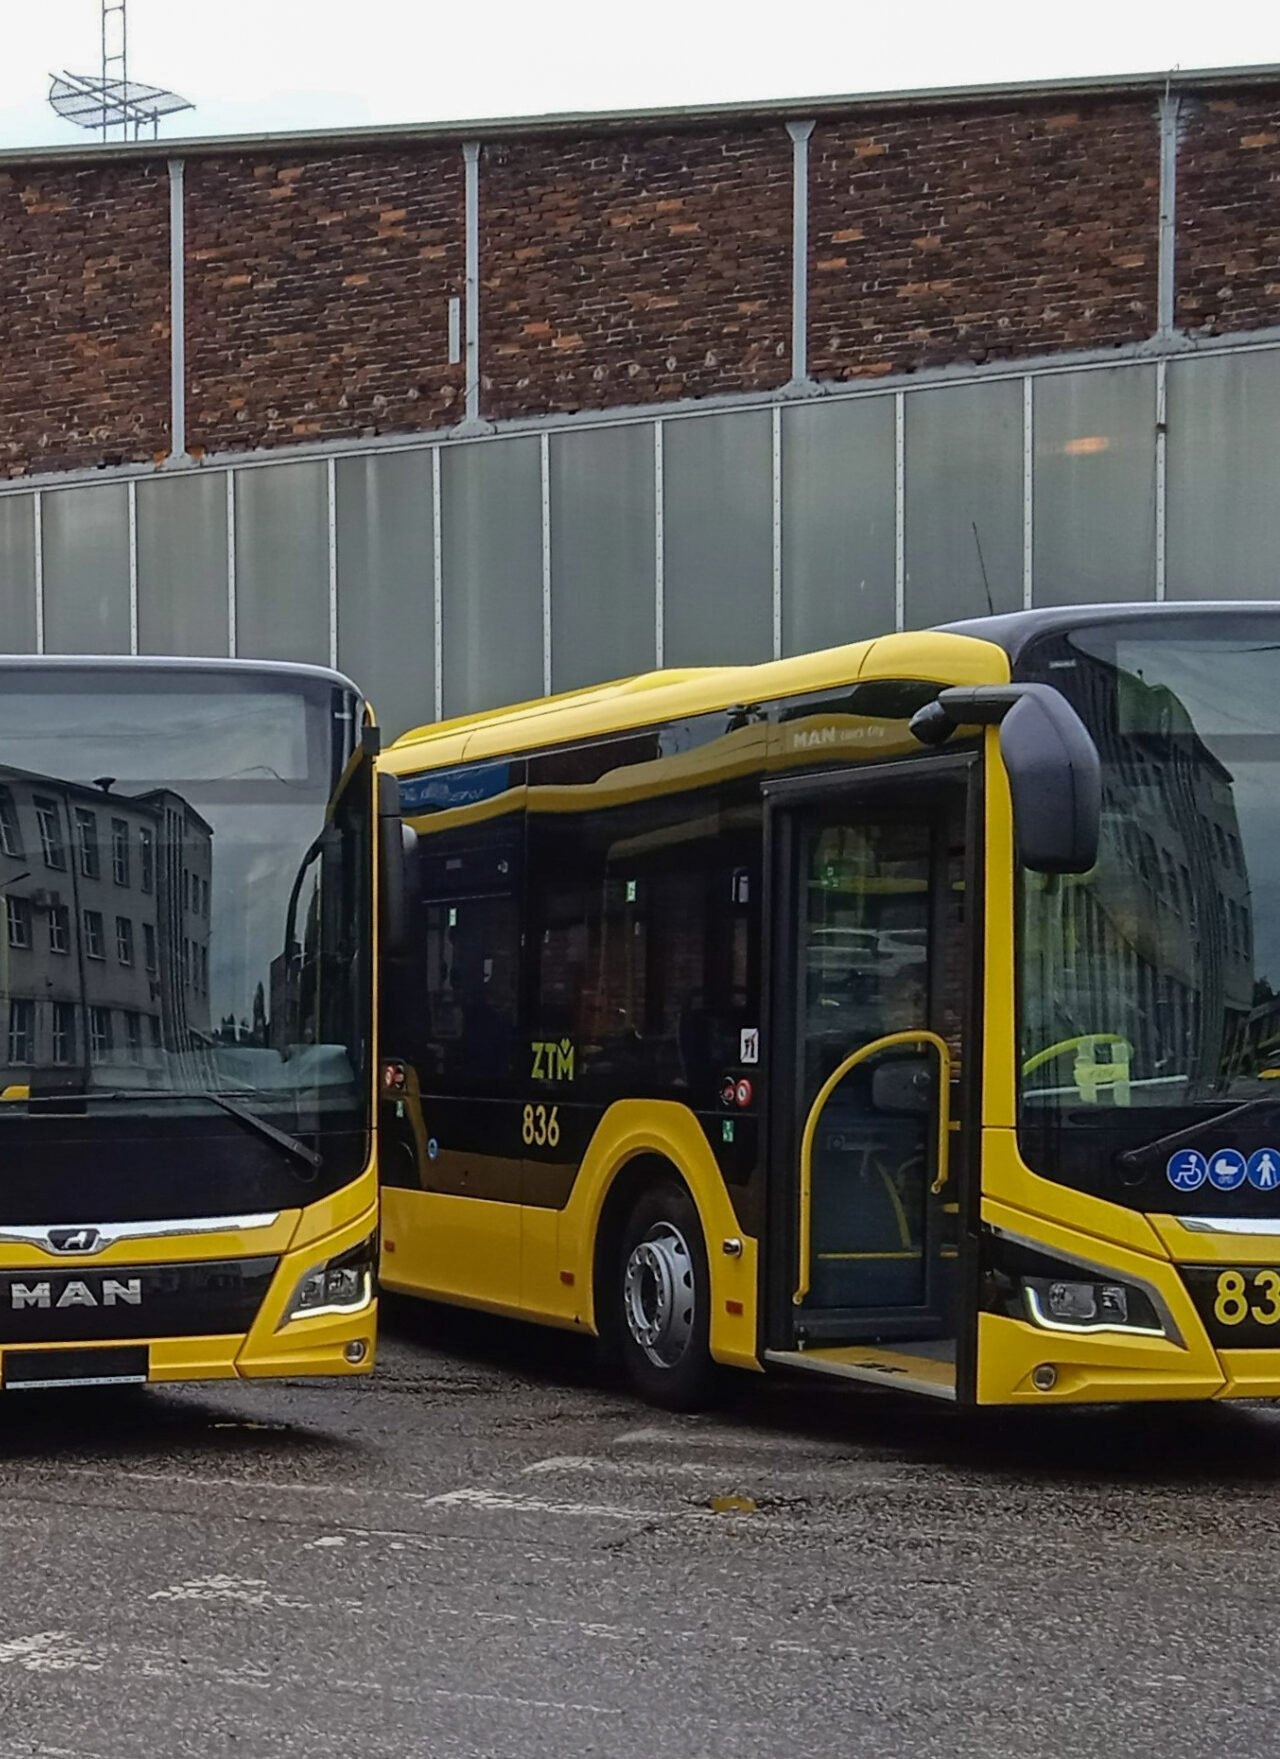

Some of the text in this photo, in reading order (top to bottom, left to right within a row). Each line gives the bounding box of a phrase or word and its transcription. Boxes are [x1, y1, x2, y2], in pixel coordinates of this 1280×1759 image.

[793, 726, 836, 748] MAN
[531, 1038, 574, 1081] ZTM
[522, 1103, 560, 1147] 836
[10, 1278, 142, 1309] MAN
